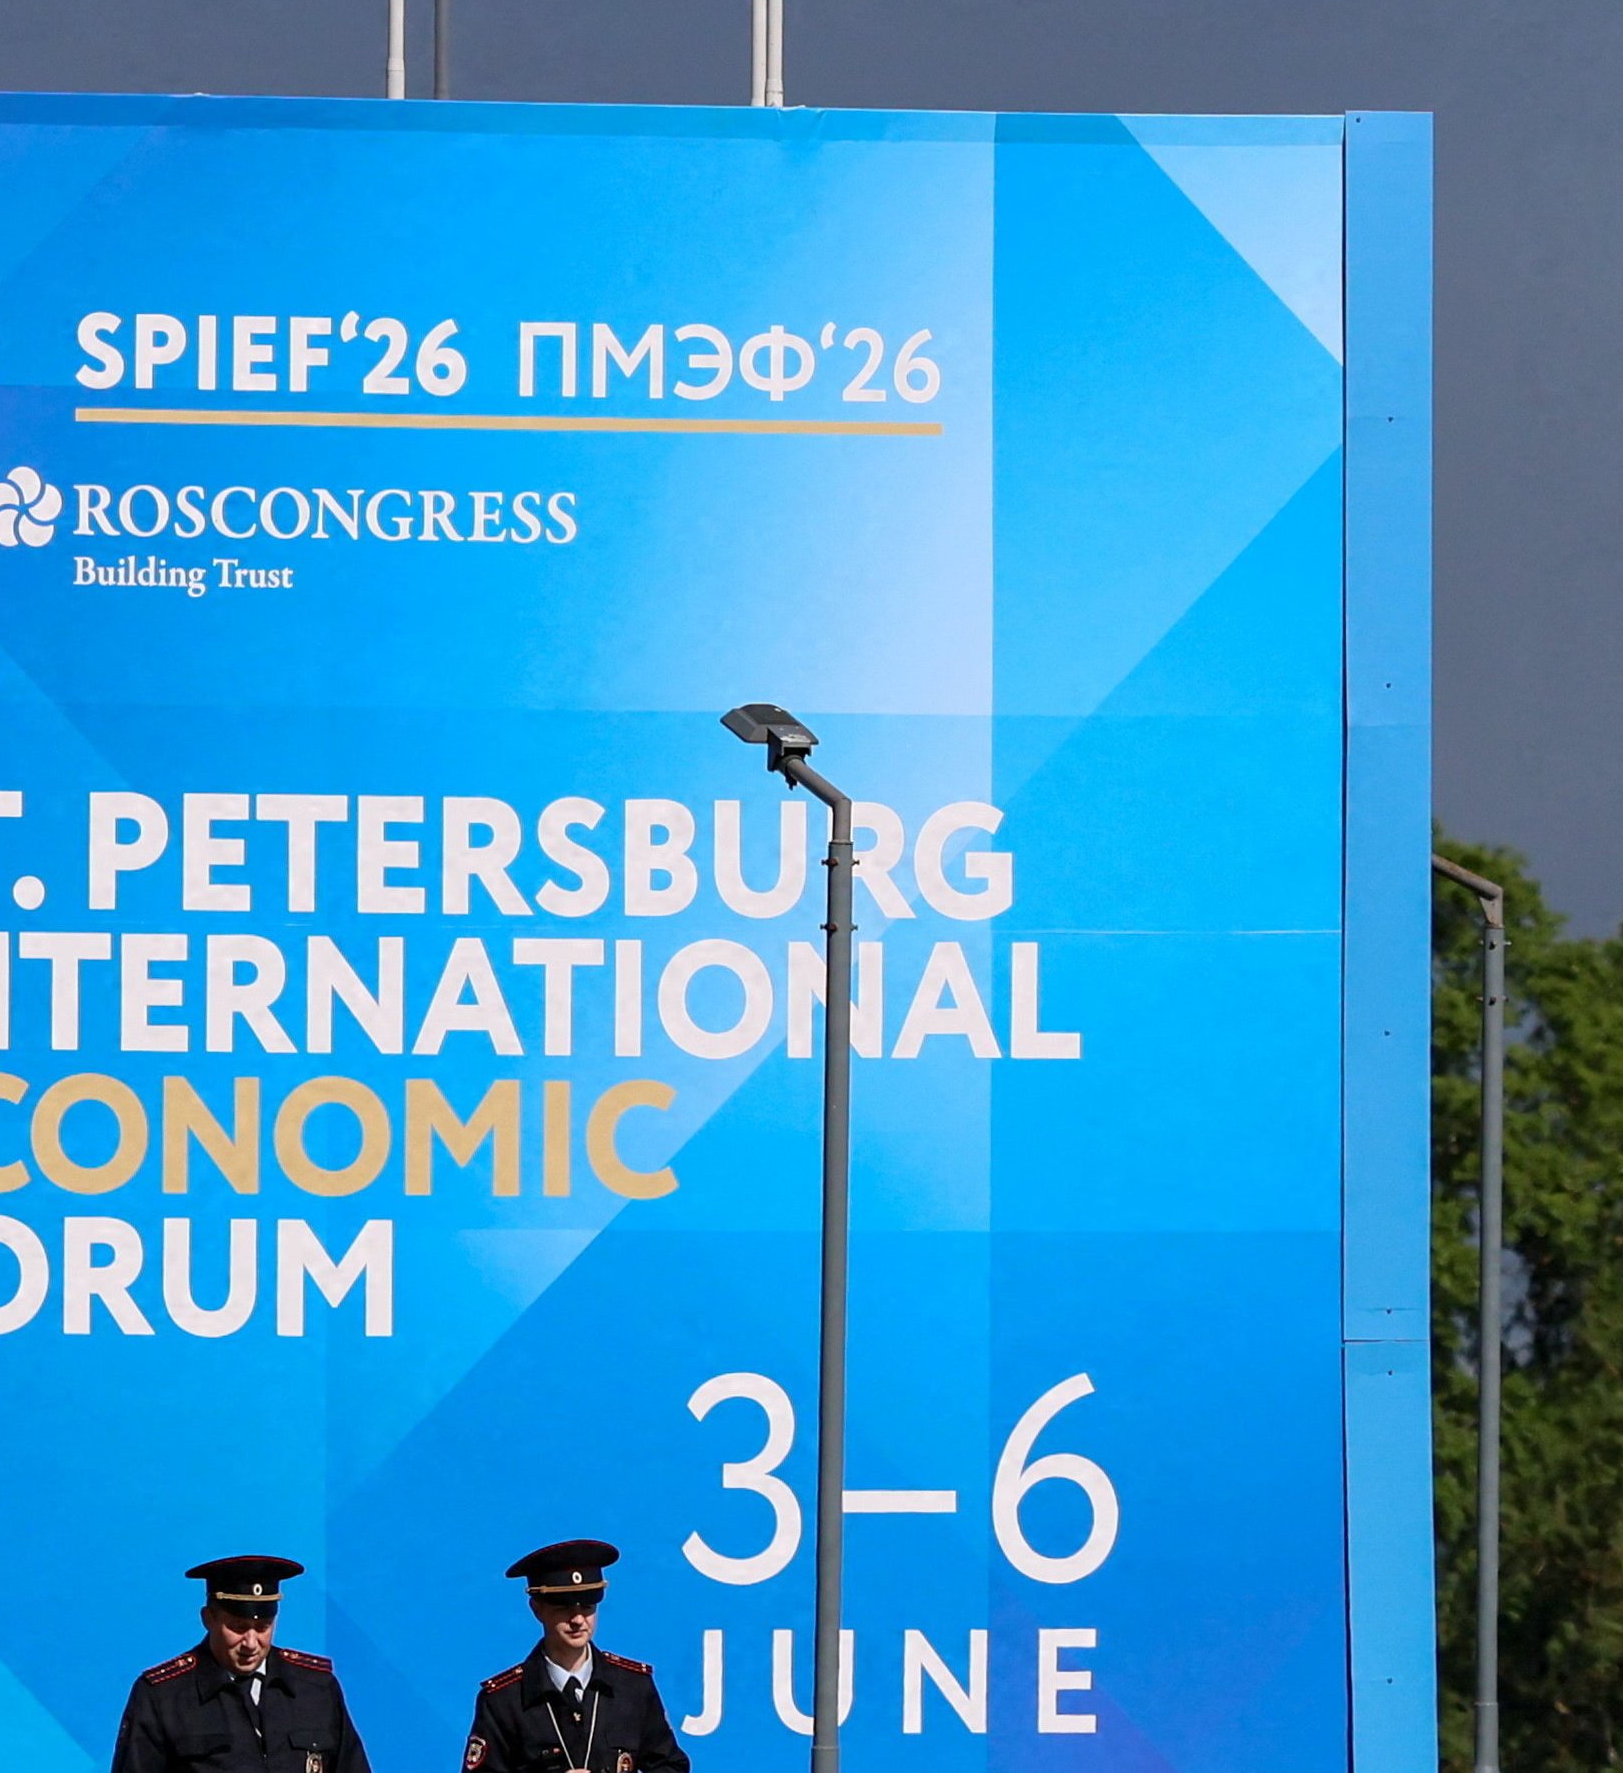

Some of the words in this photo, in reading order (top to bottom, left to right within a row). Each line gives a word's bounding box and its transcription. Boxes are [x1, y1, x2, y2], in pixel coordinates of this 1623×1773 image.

[73, 484, 578, 546] ROSCONGRESS
[73, 556, 206, 596] Building
[213, 557, 294, 590] Trust
[88, 790, 1014, 921] PETERSBURG
[680, 1628, 1097, 1736] JUNE
